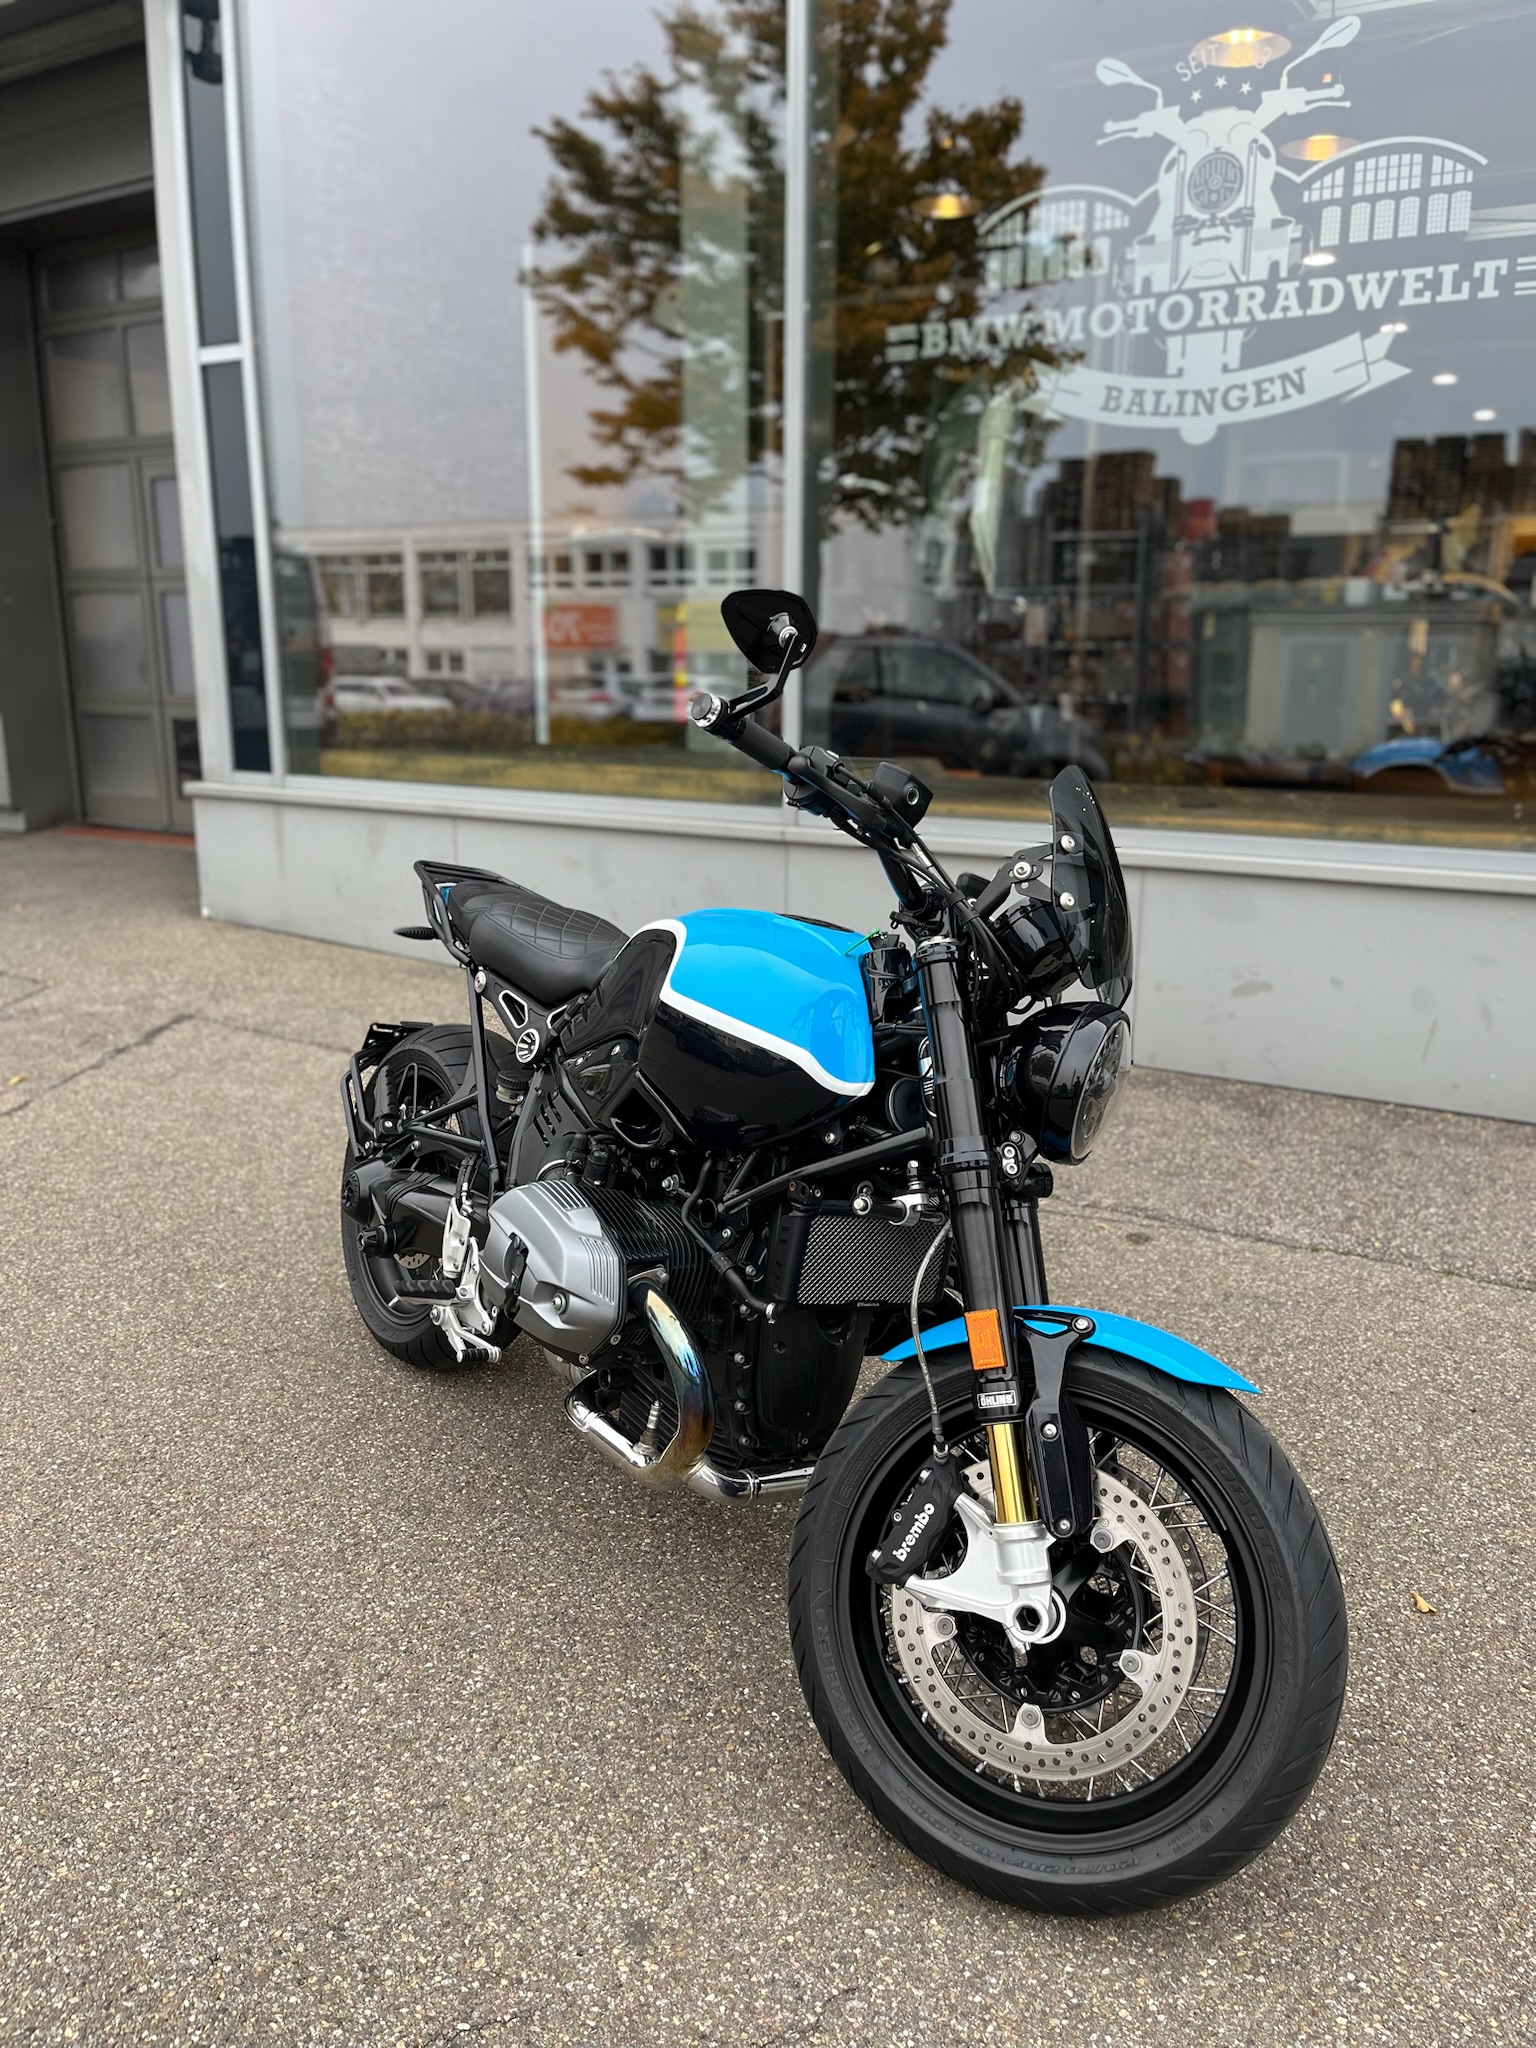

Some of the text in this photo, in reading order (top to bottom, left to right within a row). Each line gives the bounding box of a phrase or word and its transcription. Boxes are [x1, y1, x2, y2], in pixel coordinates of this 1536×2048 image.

[1174, 43, 1220, 82] SEIT
[919, 258, 1509, 360] BMW MOTORRADWELT
[1100, 366, 1307, 420] BALINGEN
[979, 1393, 1014, 1408] ÖHLINS
[892, 1503, 935, 1561] brembo
[816, 1625, 873, 1753] METZELER
